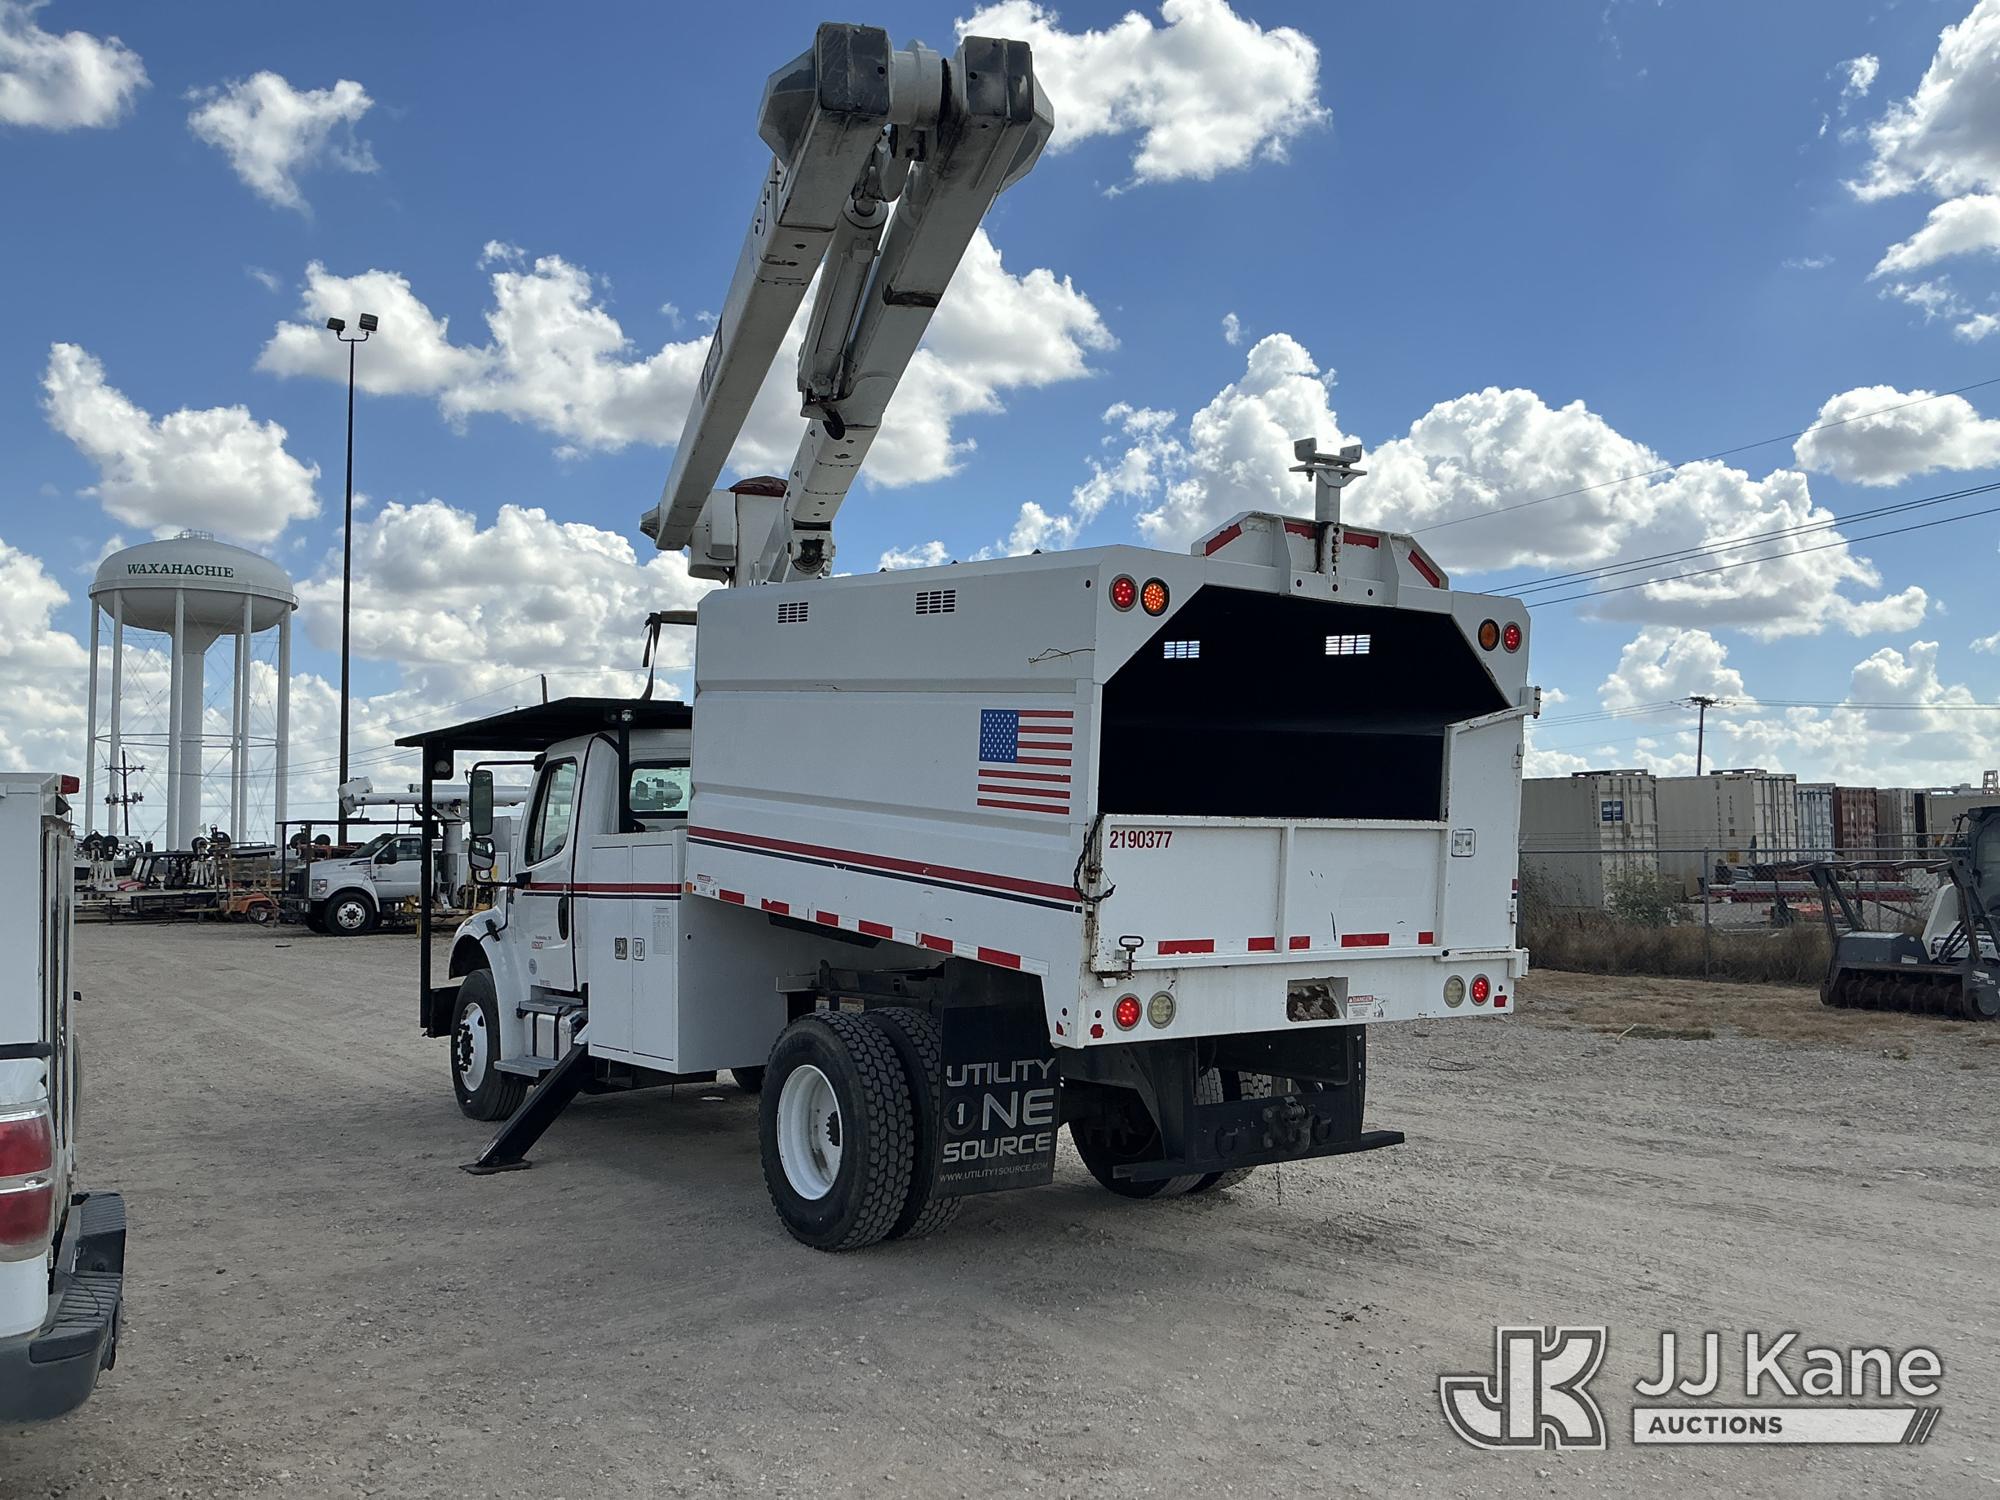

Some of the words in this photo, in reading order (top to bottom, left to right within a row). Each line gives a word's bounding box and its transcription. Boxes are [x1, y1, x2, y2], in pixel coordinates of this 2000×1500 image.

[127, 563, 234, 578] WAXAHACHIE
[1109, 830, 1173, 849] 2190377
[946, 1058, 1056, 1087] UTILITY
[942, 1132, 1052, 1164] SOURCE
